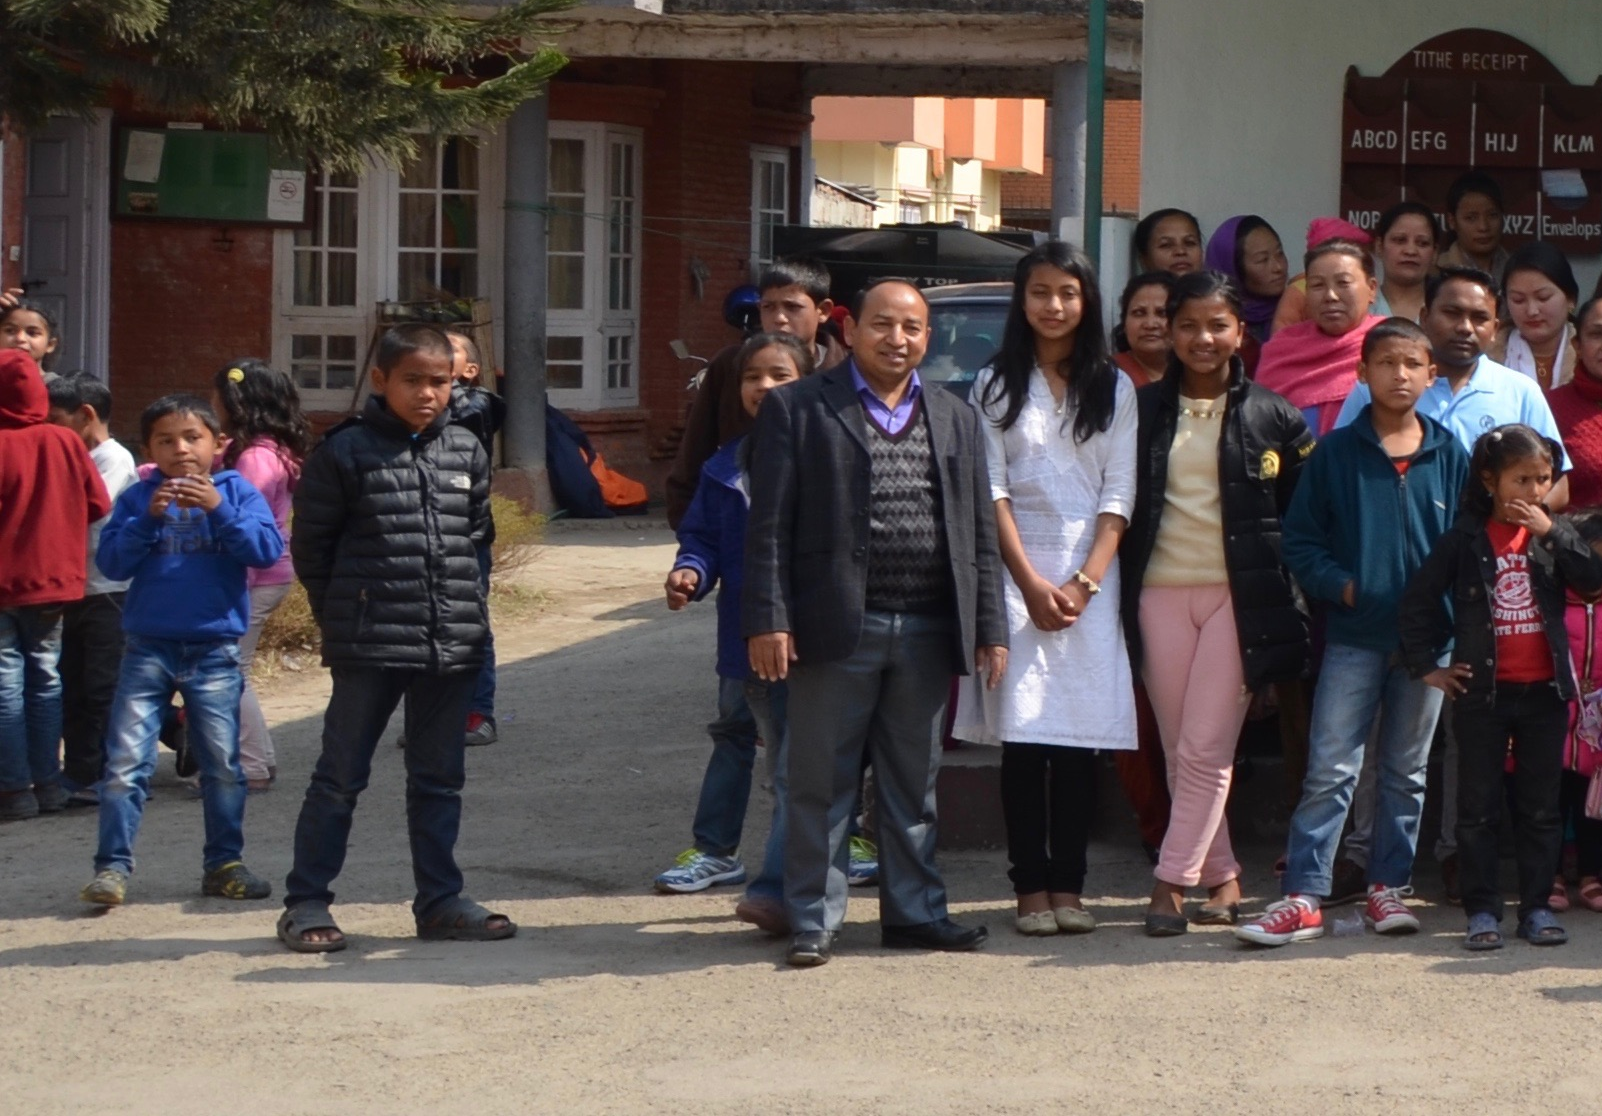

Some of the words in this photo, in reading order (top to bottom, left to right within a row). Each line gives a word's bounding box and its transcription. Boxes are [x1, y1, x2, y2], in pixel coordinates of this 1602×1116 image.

[1413, 50, 1453, 69] TITHE
[1351, 129, 1397, 149] ABCD
[1410, 131, 1447, 150] EFG
[1485, 133, 1518, 152] HIJ
[1553, 134, 1594, 153] KLM
[1542, 215, 1601, 241] Envelops
